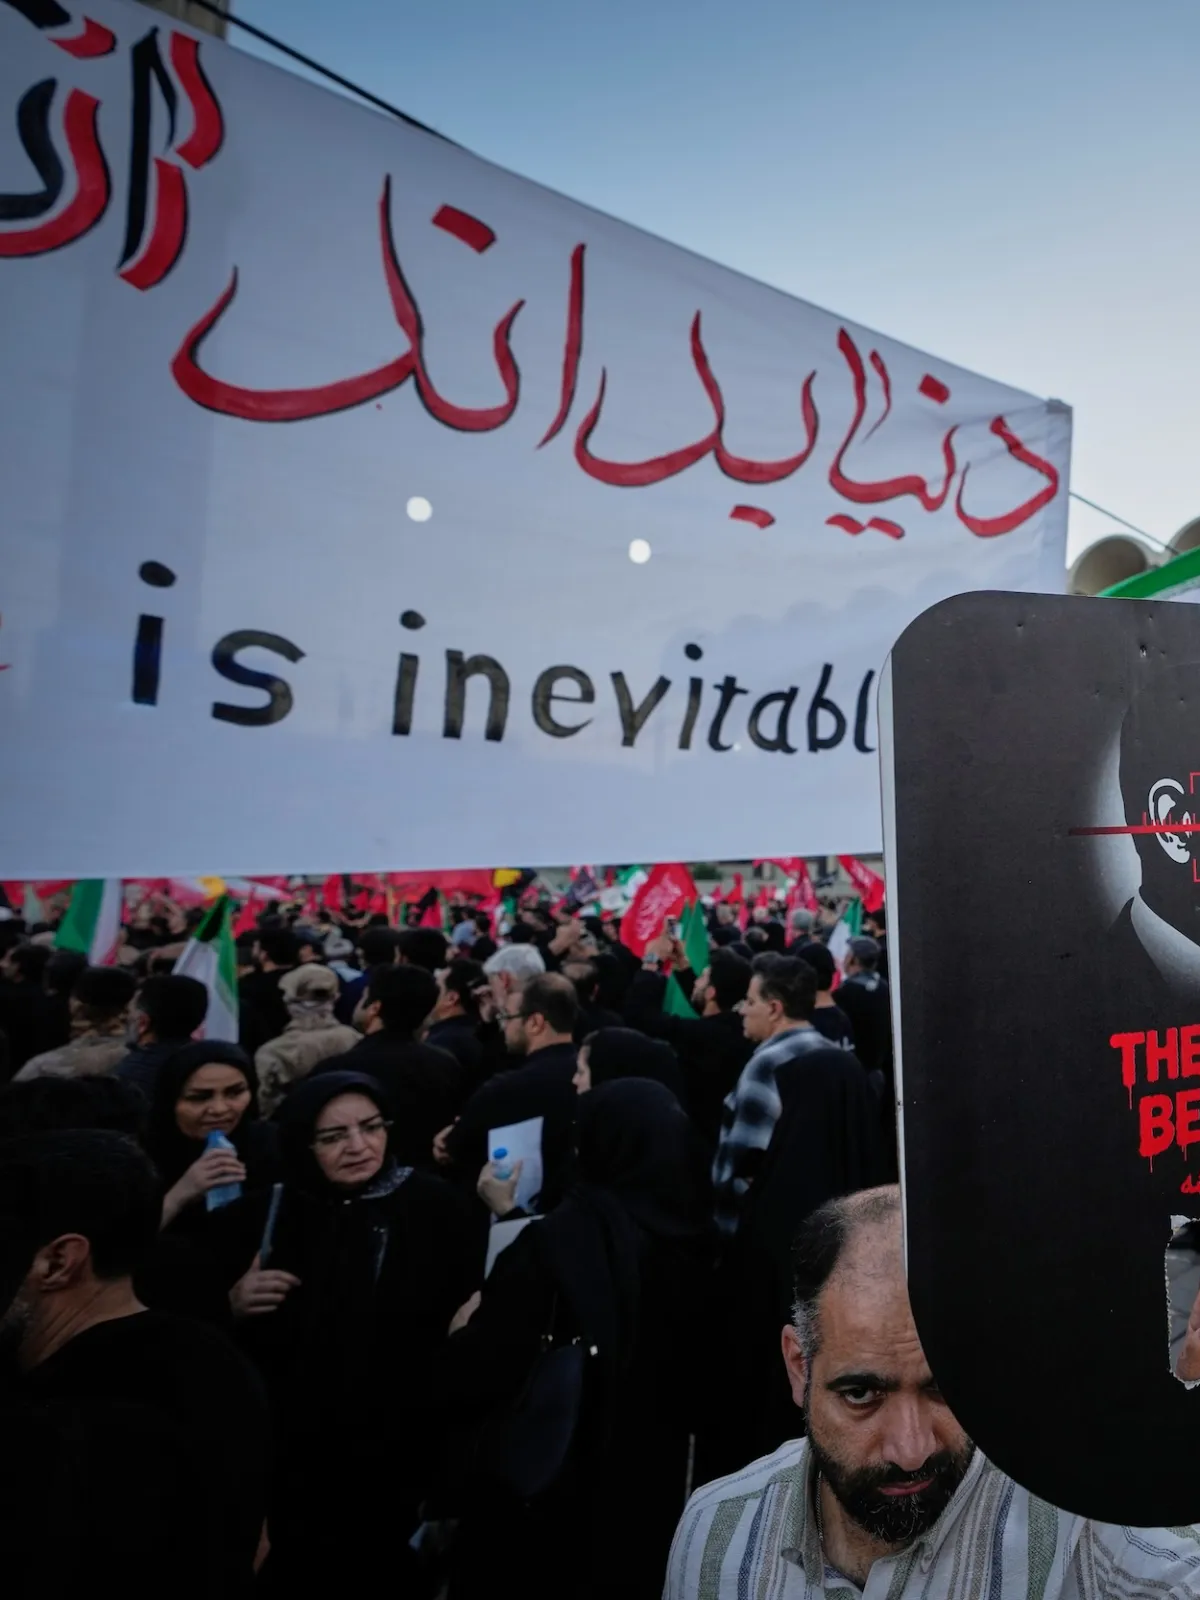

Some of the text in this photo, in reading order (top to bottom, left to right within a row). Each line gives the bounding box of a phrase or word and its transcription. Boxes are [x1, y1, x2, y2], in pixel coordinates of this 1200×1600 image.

[826, 326, 1059, 540] دنیا
[131, 560, 876, 754] is inevitabl
